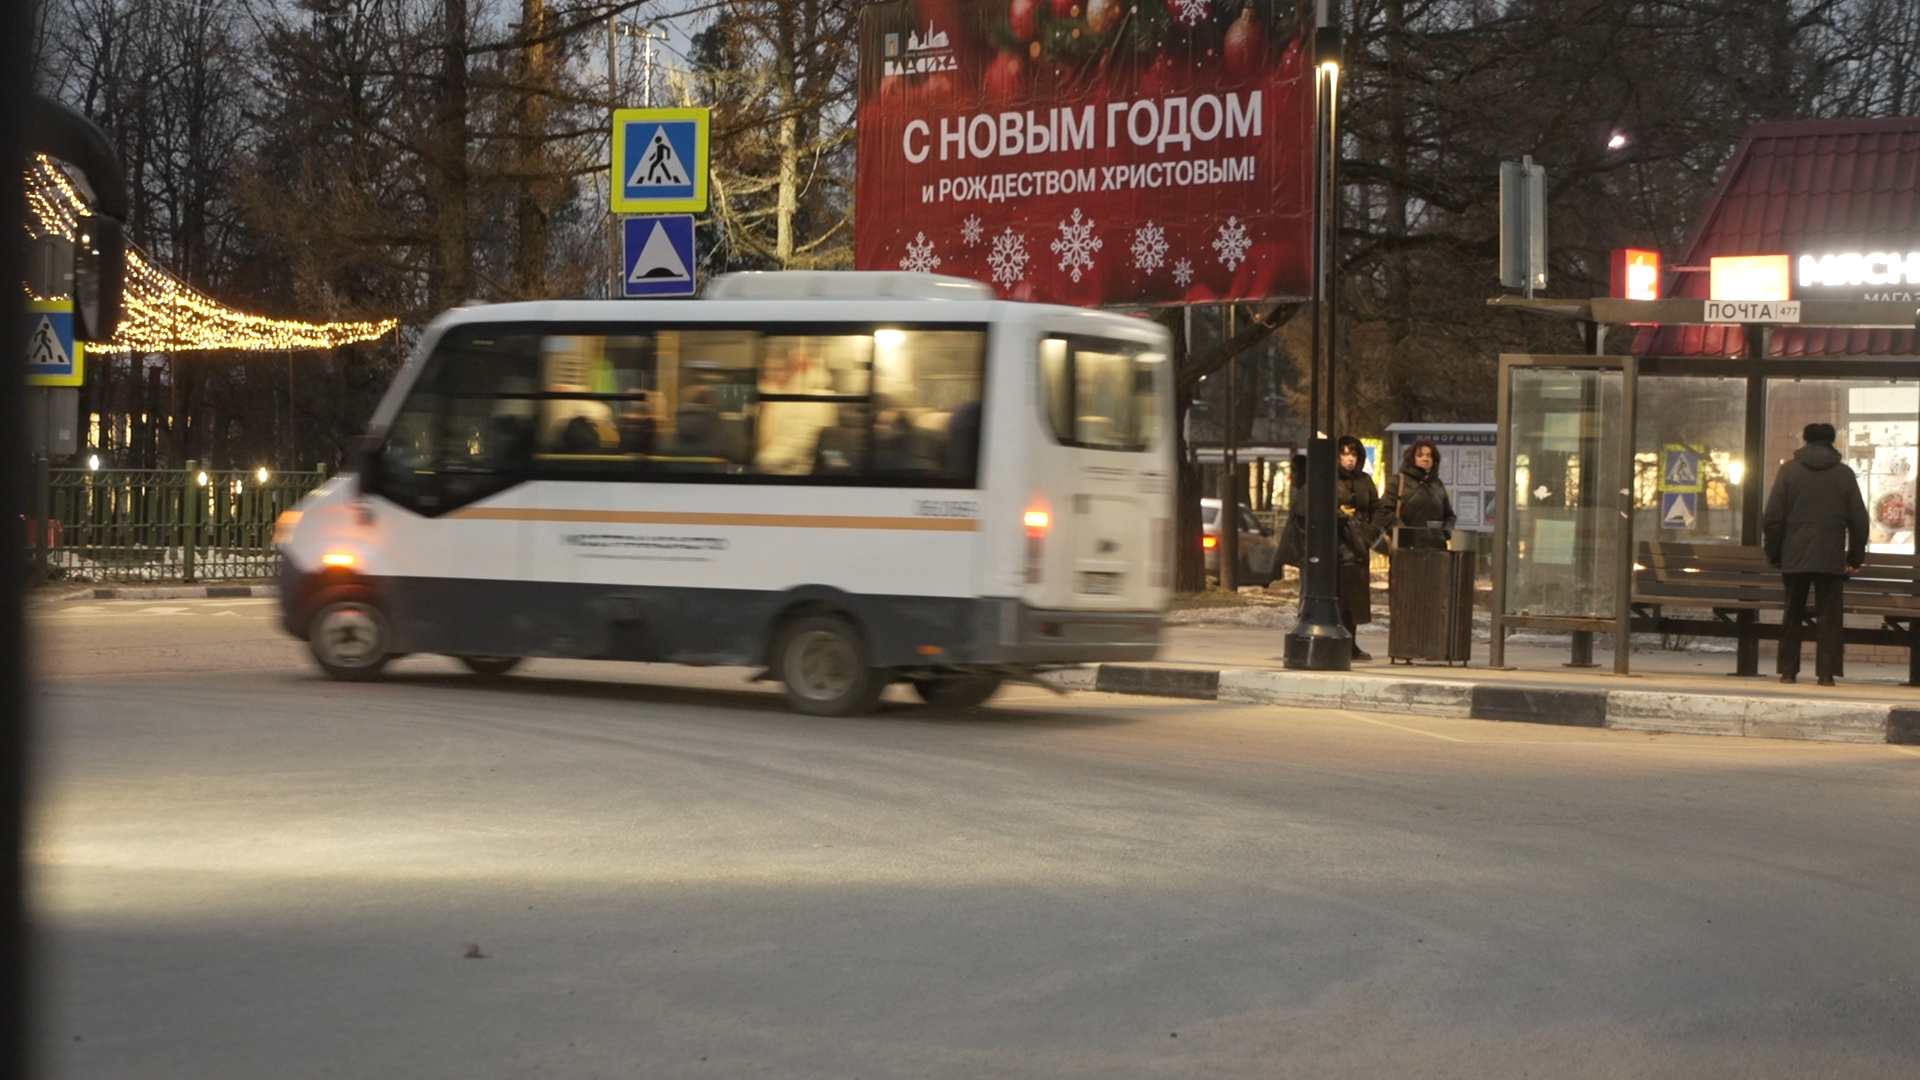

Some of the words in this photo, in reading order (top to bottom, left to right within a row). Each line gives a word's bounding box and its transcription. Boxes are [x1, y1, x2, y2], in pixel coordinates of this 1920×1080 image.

[903, 119, 930, 164] С
[940, 105, 1095, 161] НОВЫМ
[1107, 90, 1263, 153] ГОДОМ
[922, 185, 935, 203] и
[939, 168, 1096, 203] РОЖДЕСТВОМ
[1101, 156, 1255, 191] ХРИСТОВЫМ!
[1799, 252, 1920, 287] МЯСН
[1708, 303, 1771, 319] ПОЧТА
[1780, 307, 1798, 317] 477
[1416, 434, 1496, 443] ИНФОРМАЦИЯ
